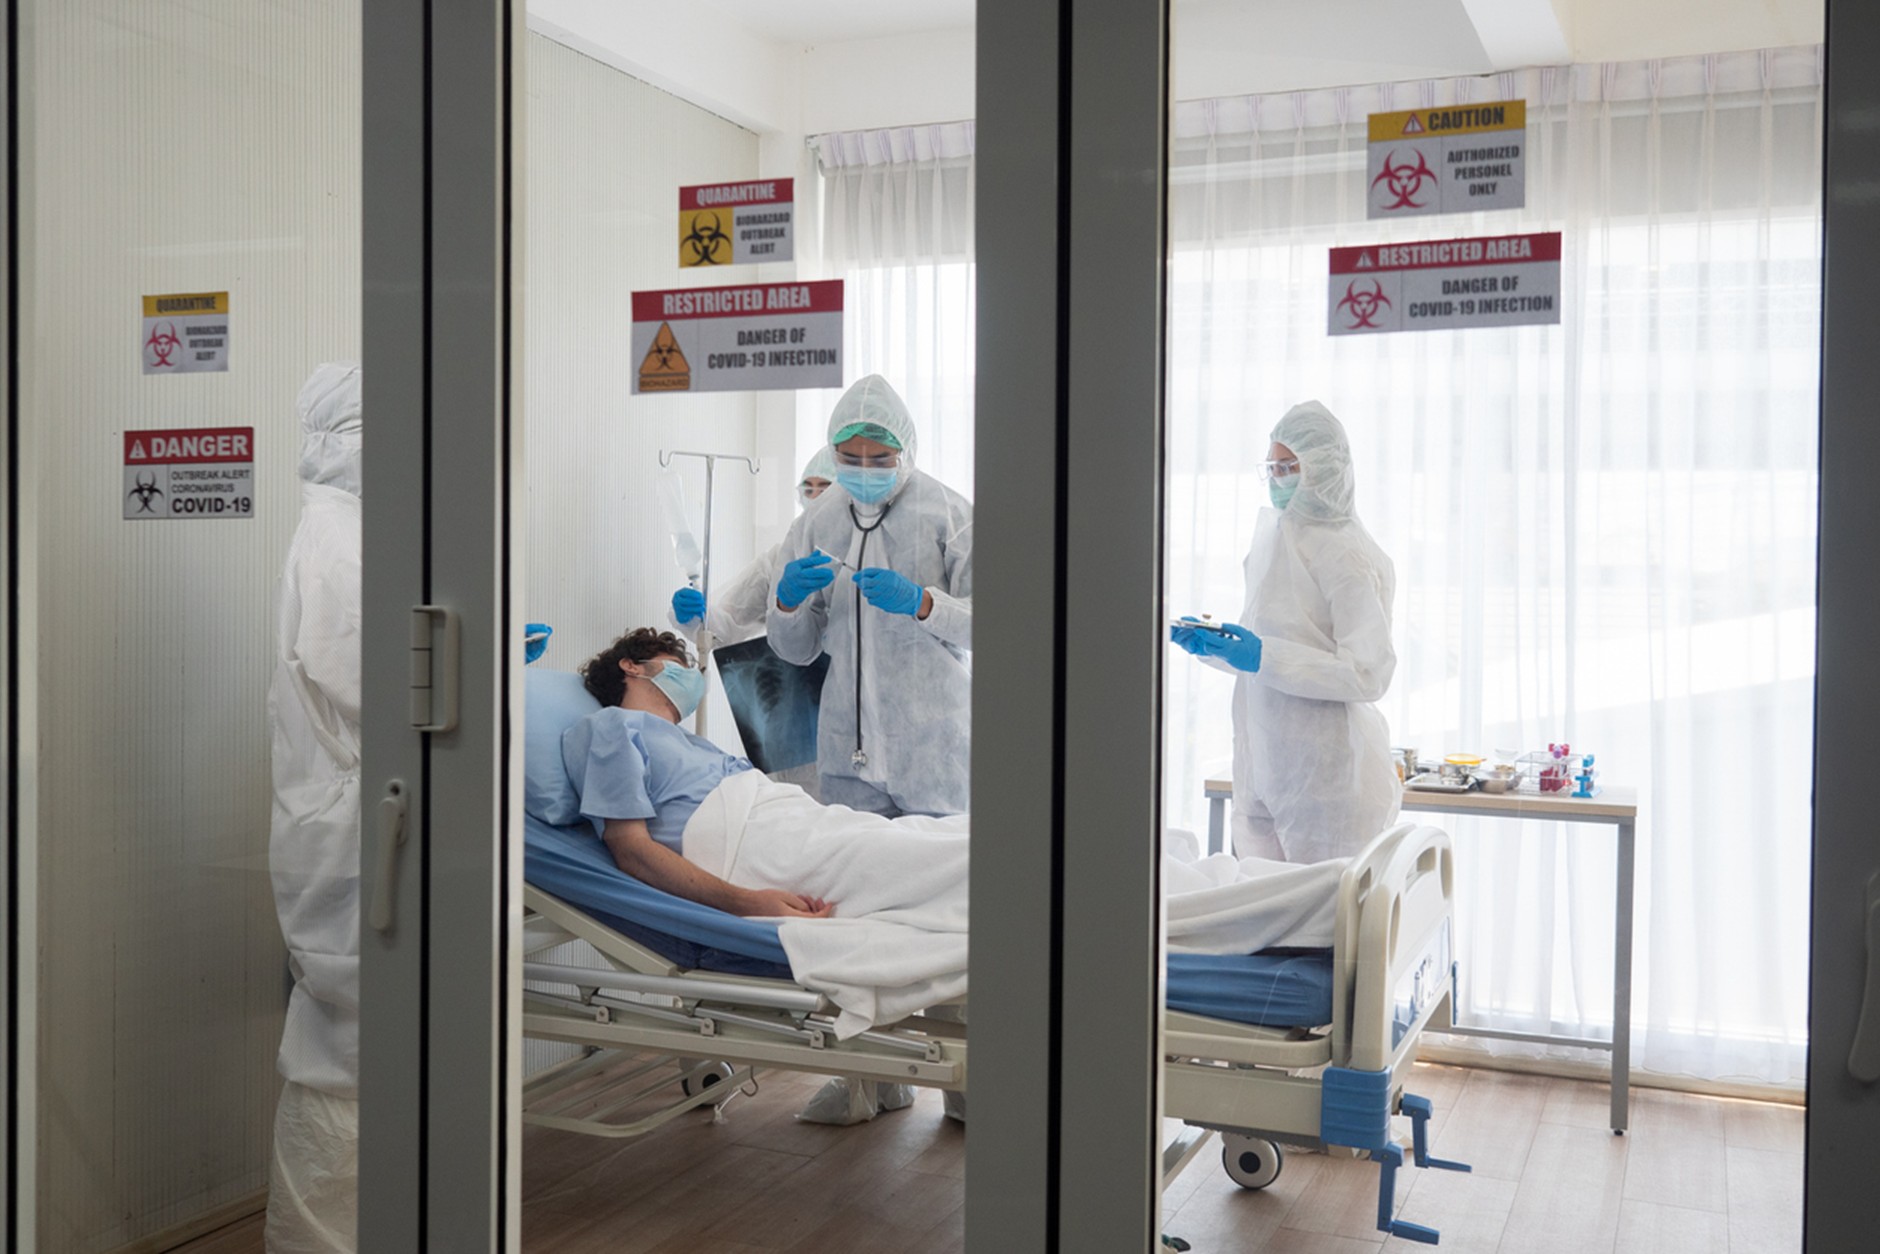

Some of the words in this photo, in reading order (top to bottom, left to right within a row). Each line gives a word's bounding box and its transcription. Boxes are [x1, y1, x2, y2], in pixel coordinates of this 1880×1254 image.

[1429, 106, 1505, 131] CAUTION
[1447, 145, 1520, 163] AUTHORIZED
[1454, 164, 1513, 180] PERSONEL
[697, 182, 776, 206] QUARANTINE
[1469, 182, 1497, 196] ONLY
[741, 227, 785, 241] OUTBREAK
[750, 243, 775, 255] ALERT
[1378, 242, 1482, 266] RESTRICTED
[1485, 238, 1532, 259] AREA
[1442, 277, 1497, 295] DANGER
[1502, 276, 1519, 291] OF
[663, 289, 764, 315] RESTRICTED
[767, 286, 811, 309] AREA
[1409, 300, 1475, 318] COVID-19
[1478, 296, 1553, 314] INFECTION
[737, 329, 787, 346] DANGER
[790, 328, 806, 343] OF
[708, 352, 766, 369] COVID-19
[769, 349, 837, 366] INFECTION
[151, 435, 249, 458] DANGER
[171, 470, 219, 480] OUTBREAK
[222, 469, 250, 479] ALERT
[171, 483, 235, 493] CORONAVIRUS
[172, 497, 251, 513] COVID-19
